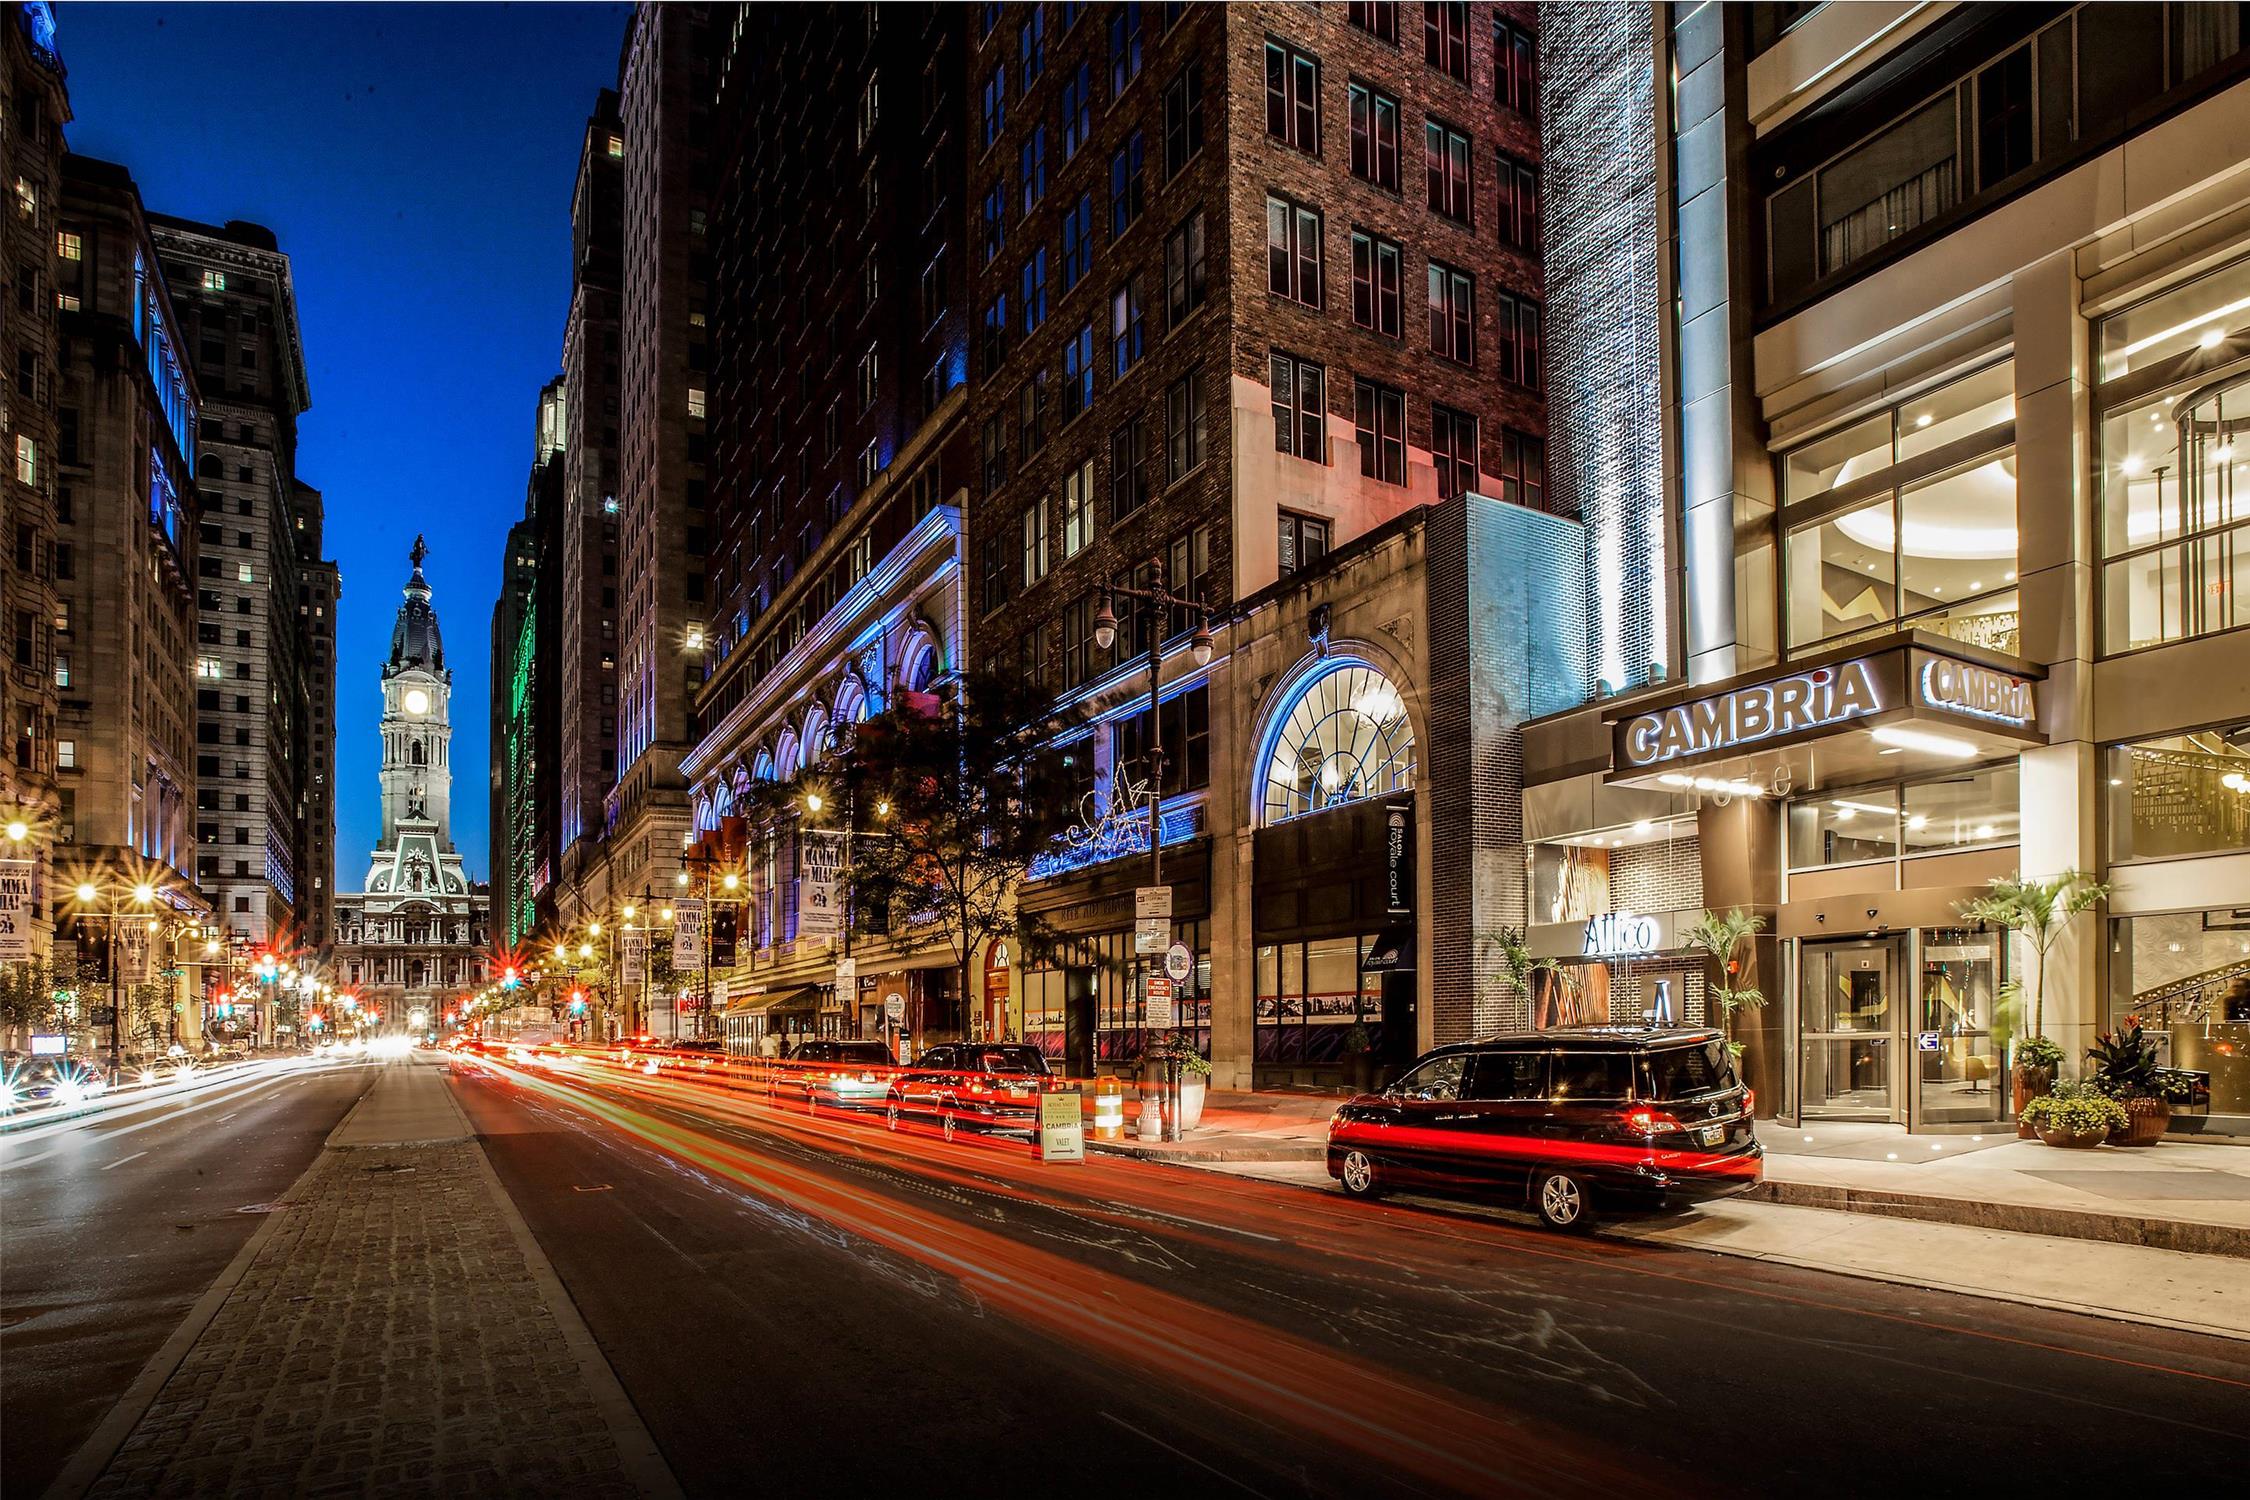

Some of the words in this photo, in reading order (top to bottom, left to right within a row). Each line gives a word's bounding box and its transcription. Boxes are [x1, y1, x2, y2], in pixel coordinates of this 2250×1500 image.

[1389, 827, 1398, 869] royale
[0, 878, 29, 894] MMA
[1389, 870, 1400, 907] court
[1046, 1122, 1079, 1130] CAMBRIA
